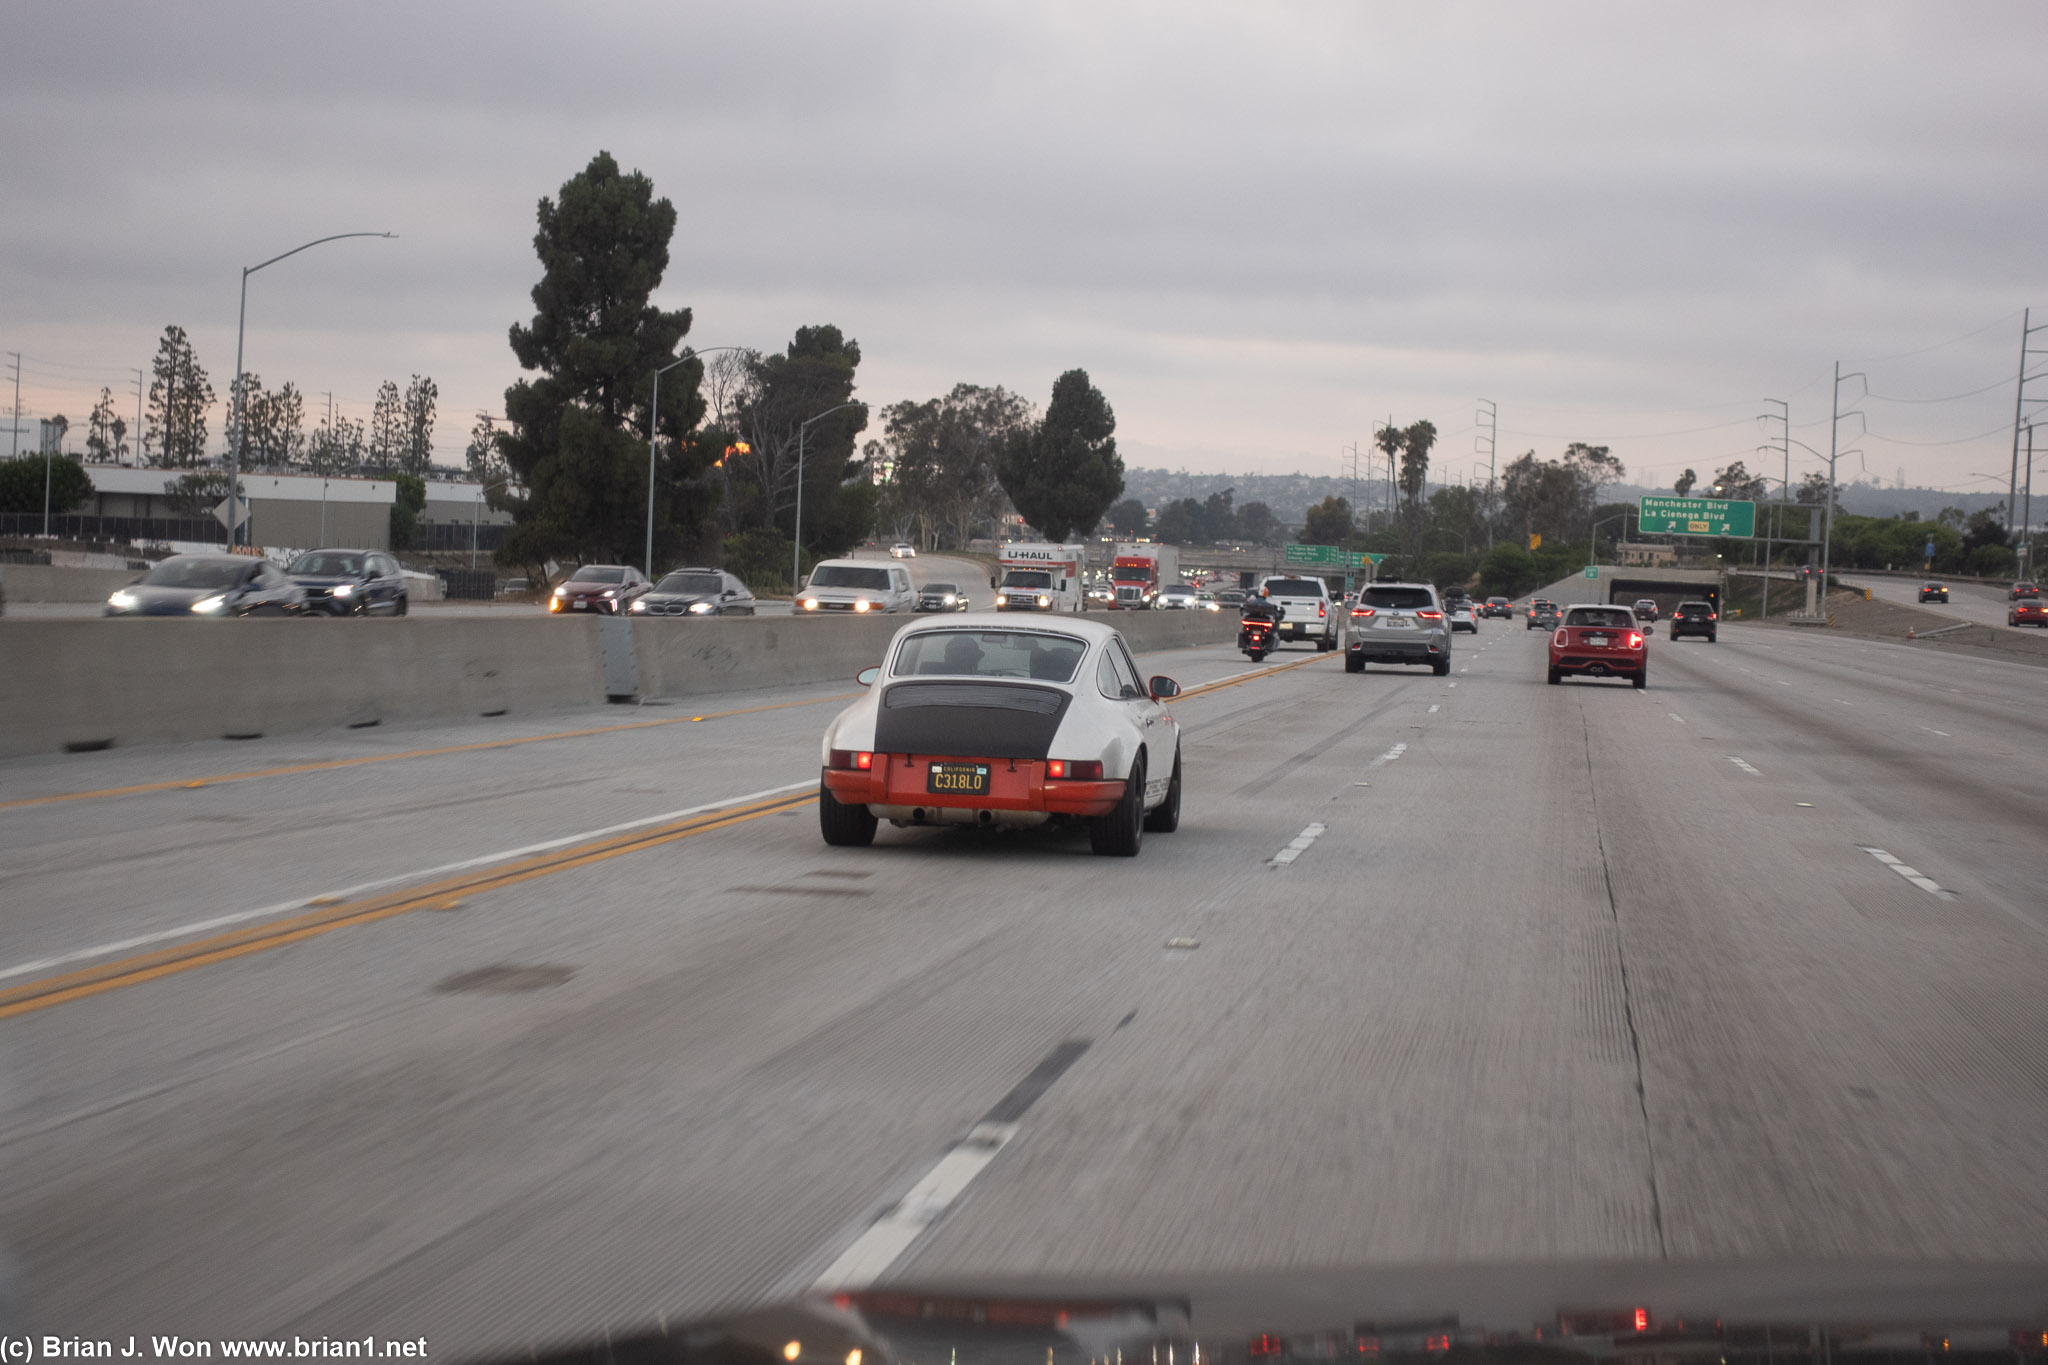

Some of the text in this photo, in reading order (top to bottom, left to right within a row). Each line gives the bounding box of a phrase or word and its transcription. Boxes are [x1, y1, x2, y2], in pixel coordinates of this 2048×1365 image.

[1645, 499, 1729, 510] Manchester Blvd
[1661, 510, 1700, 520] Cienega
[1703, 512, 1725, 520] Blvd
[1008, 551, 1053, 560] U-HAUL
